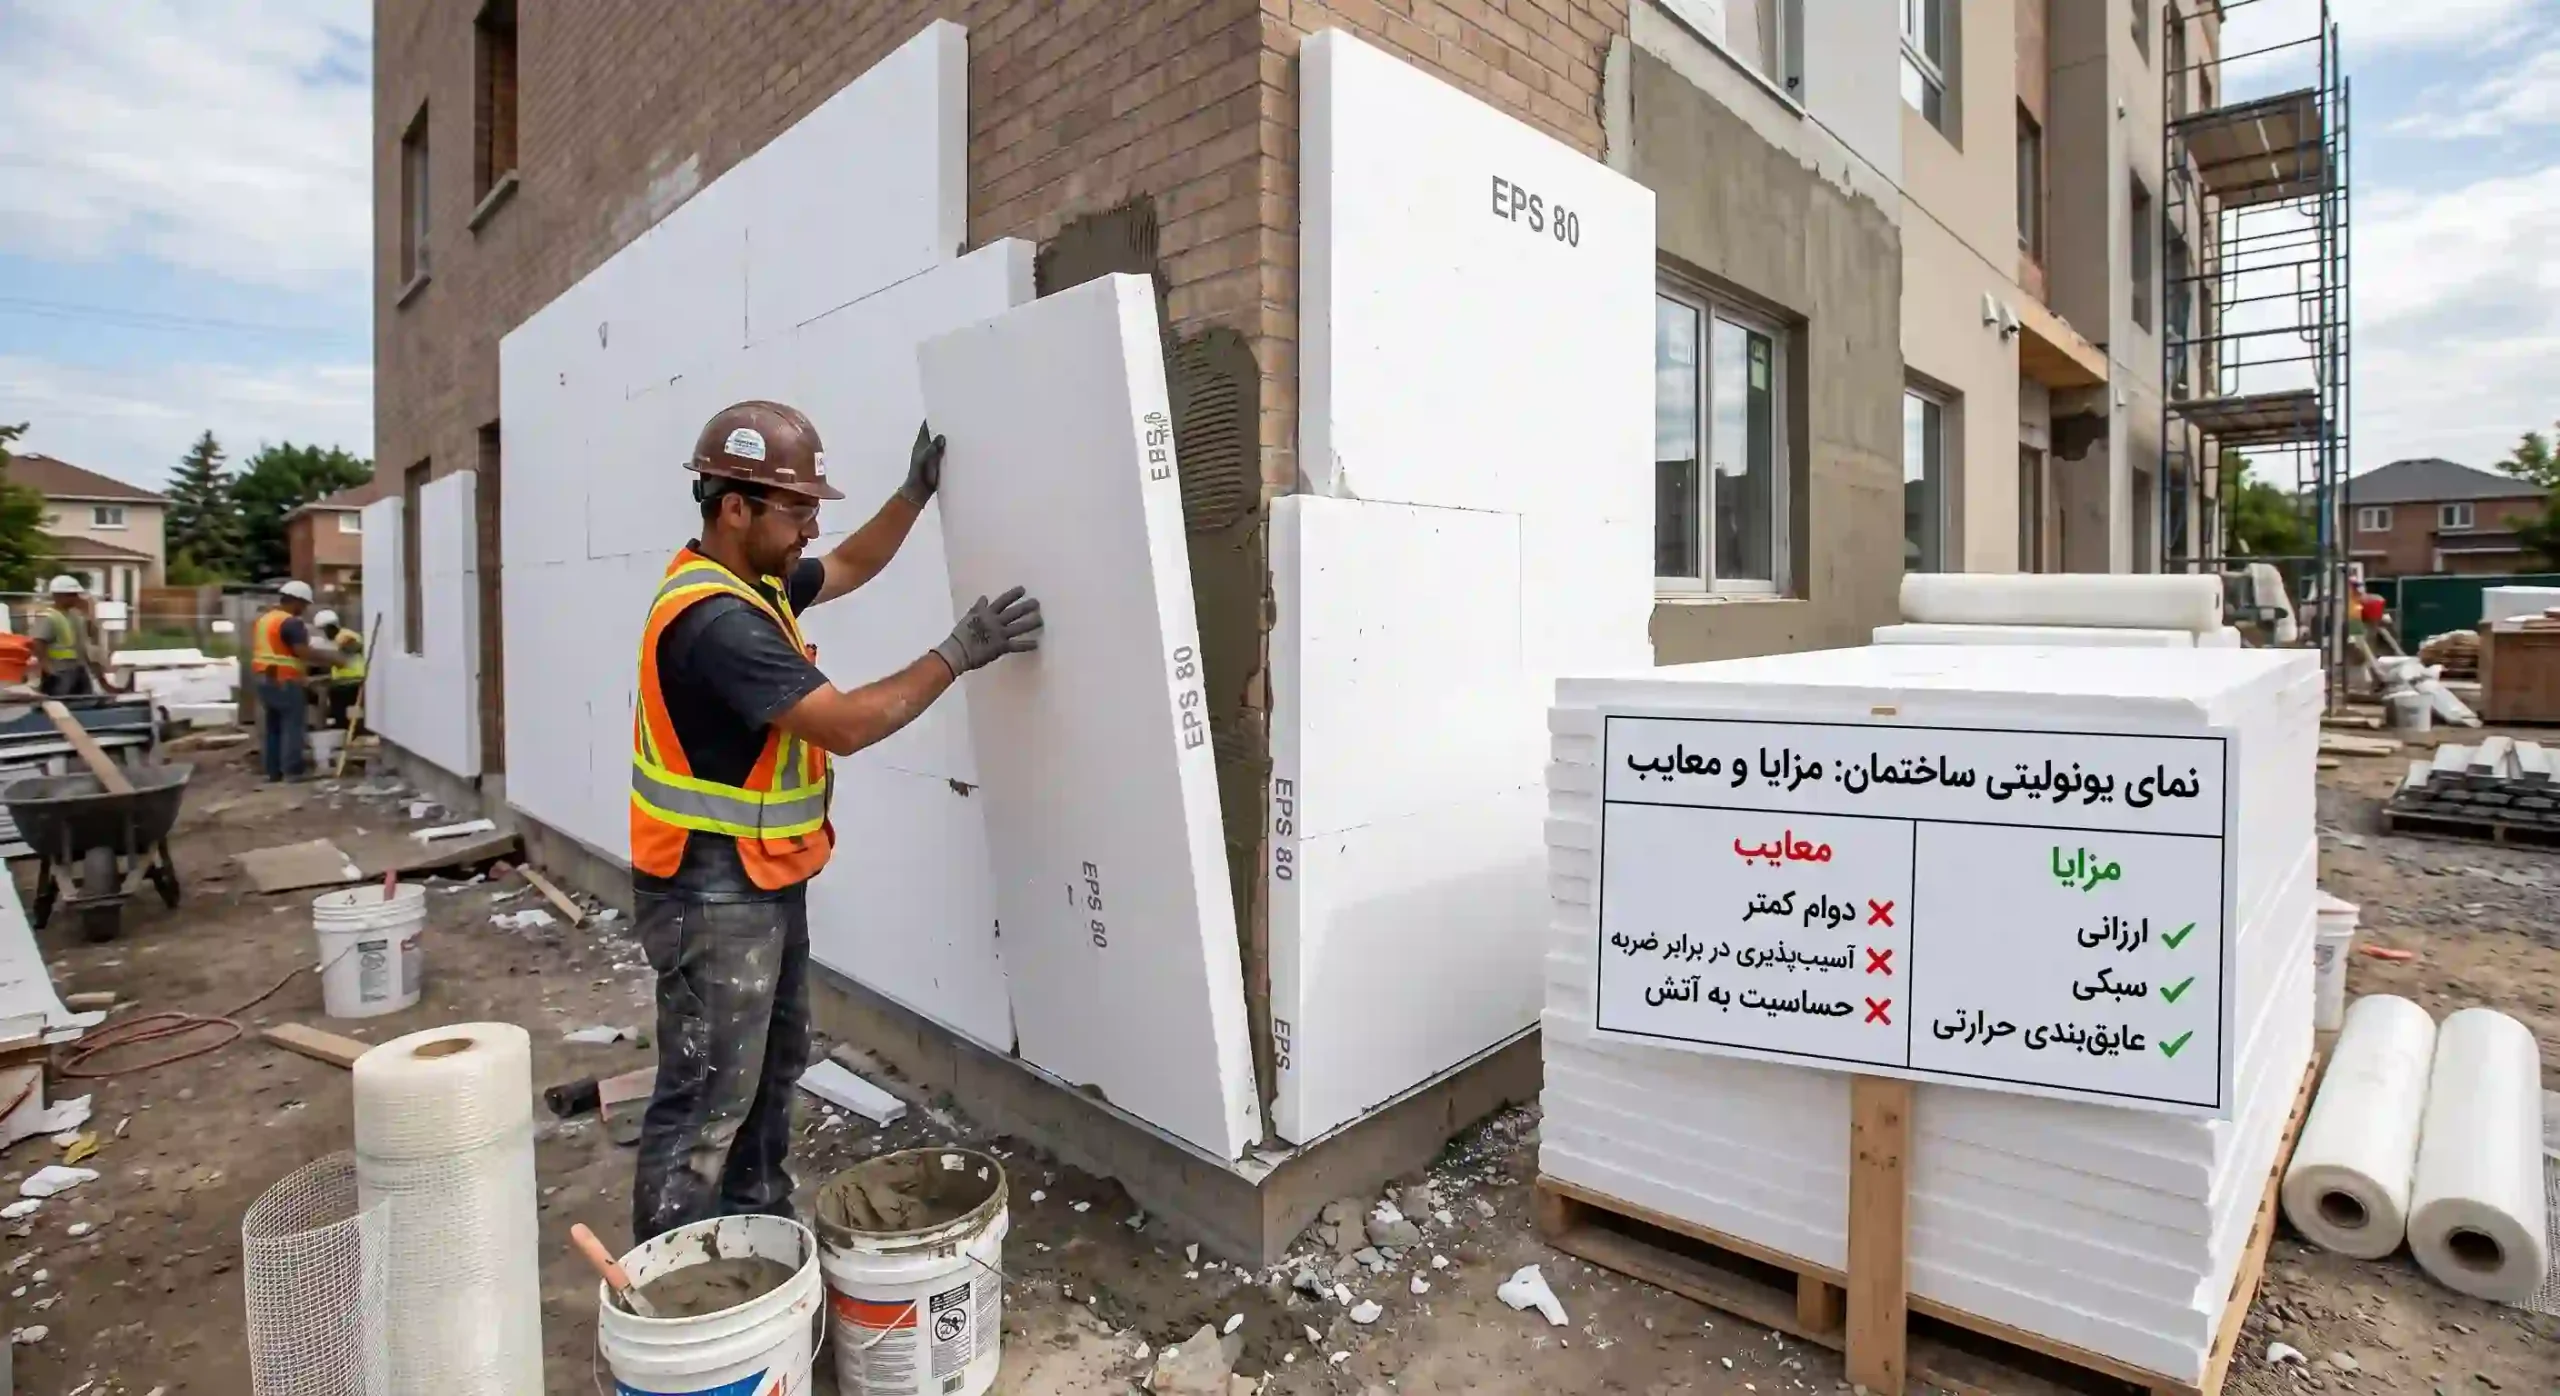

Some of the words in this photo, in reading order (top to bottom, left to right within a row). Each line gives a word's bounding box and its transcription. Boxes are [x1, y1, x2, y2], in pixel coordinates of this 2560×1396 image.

[1491, 175, 1545, 232] EPS
[1553, 204, 1580, 248] 80
[1173, 645, 1195, 681] 80
[1179, 690, 1204, 750] EPS
[1628, 744, 1721, 779] معایب
[1731, 758, 1747, 788] و
[1760, 747, 1822, 792] مزایا
[1835, 752, 1975, 794] ساختمان:
[1986, 760, 2114, 805] یونولیتی
[2125, 766, 2199, 808] نمای
[1275, 778, 1293, 837] EPS
[1275, 846, 1293, 881] 80
[1734, 830, 1832, 867] معایب
[1083, 861, 1102, 911] EPS
[2053, 847, 2121, 892] مزایا
[1742, 891, 1796, 922] کمتر
[1804, 894, 1856, 929] دوام
[1091, 919, 1107, 948] 80
[1611, 932, 1658, 954] ضربه
[1663, 933, 1703, 962] برابر
[2078, 916, 2148, 952] ارزانی
[1708, 942, 1730, 963] در
[1645, 975, 1701, 1006] آتش
[1708, 987, 1730, 1010] به
[1740, 989, 1854, 1017] حساسیت
[2073, 967, 2147, 1003] سبکی
[1275, 1017, 1291, 1070] EPS
[1933, 1009, 2016, 1046] حرارتی
